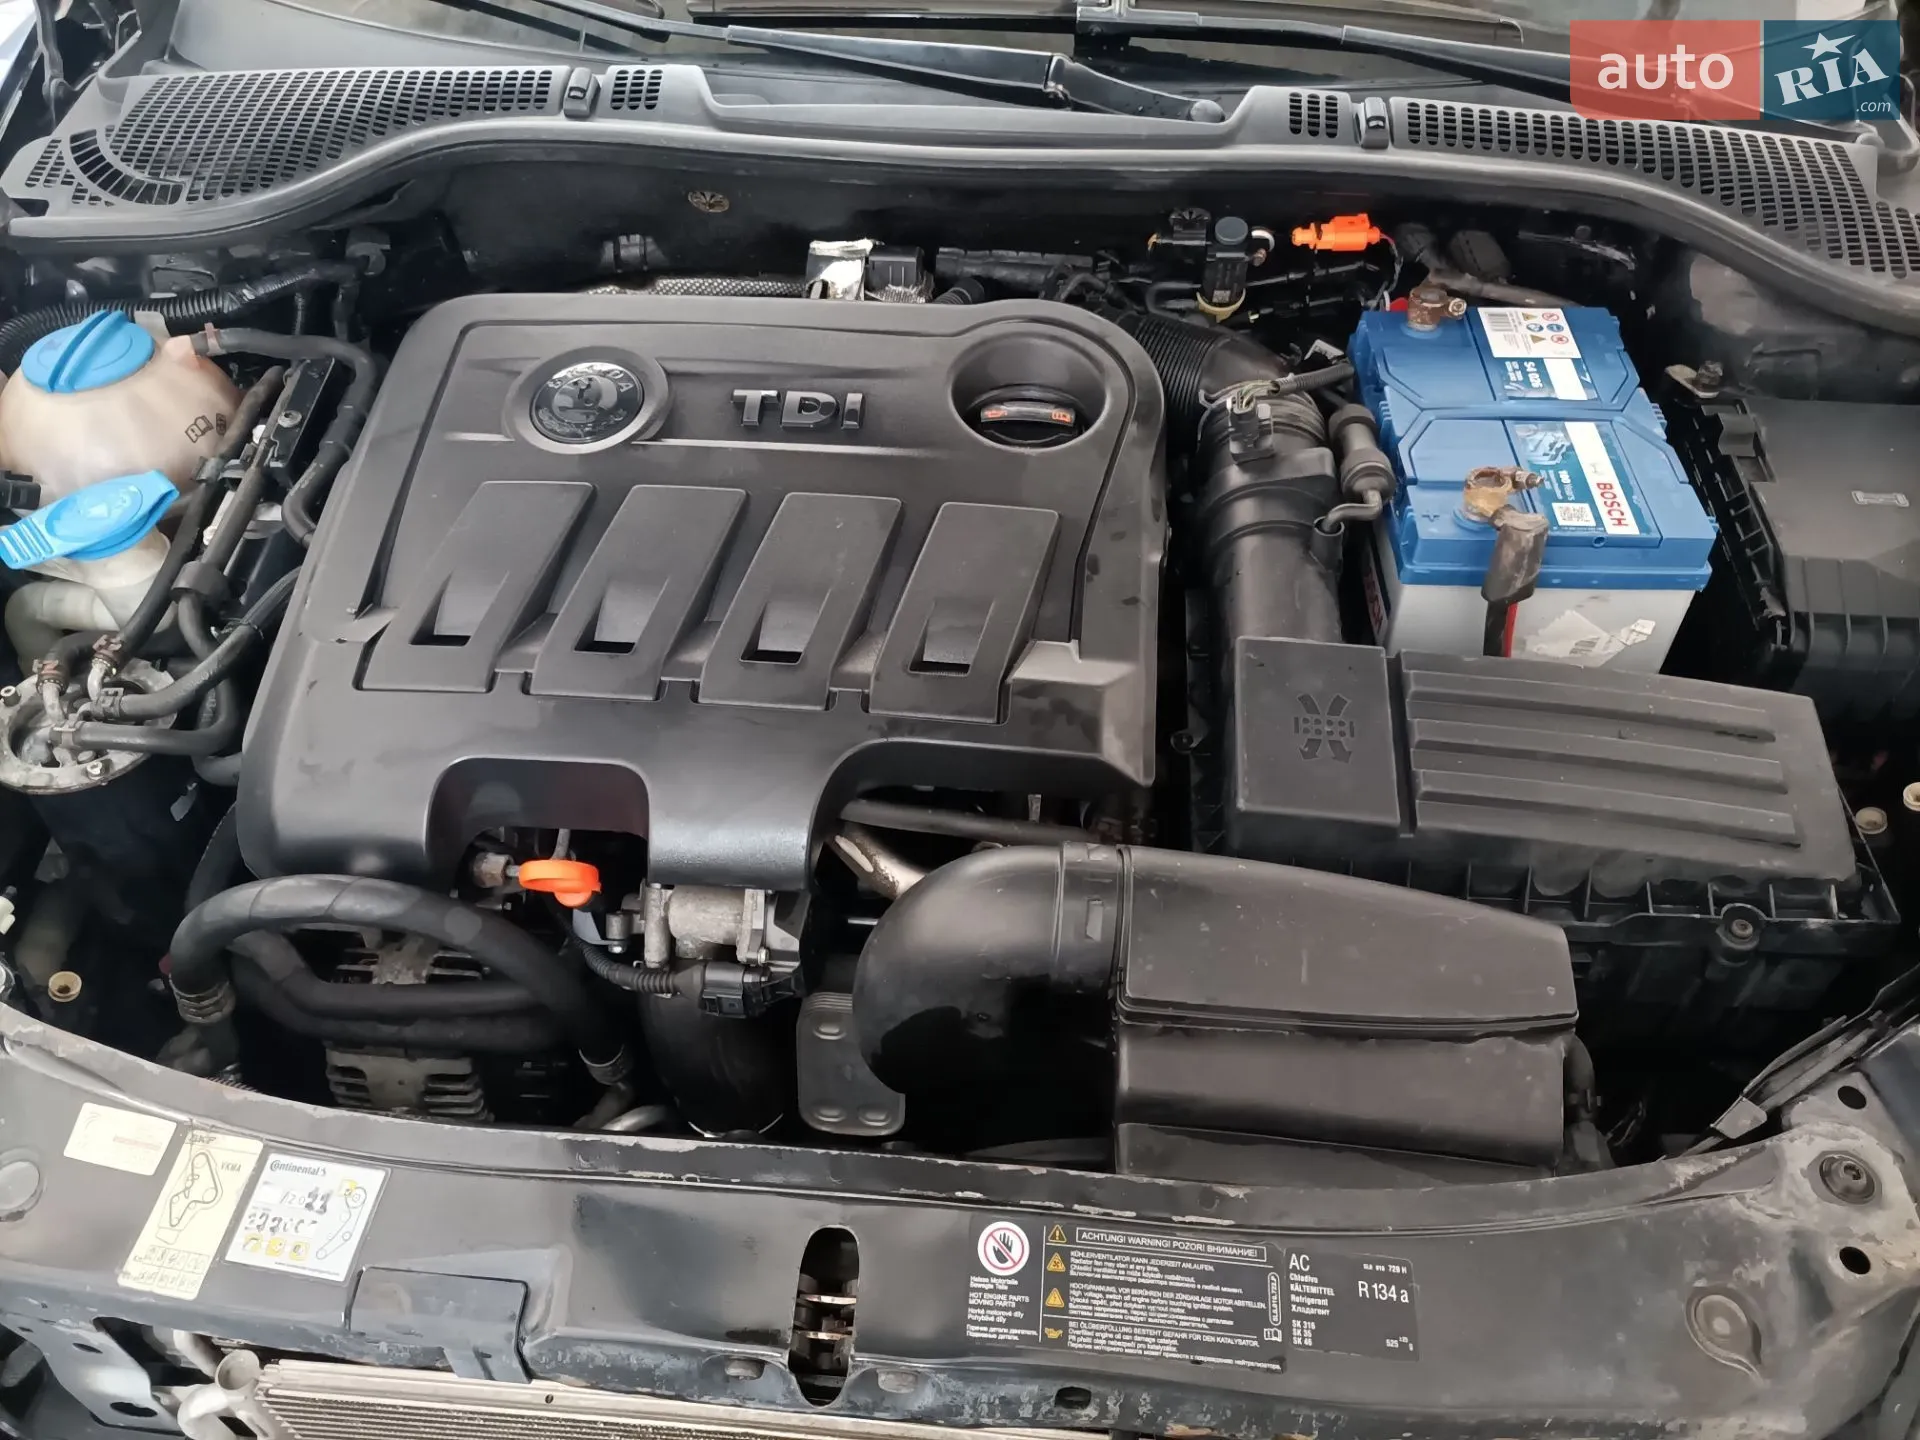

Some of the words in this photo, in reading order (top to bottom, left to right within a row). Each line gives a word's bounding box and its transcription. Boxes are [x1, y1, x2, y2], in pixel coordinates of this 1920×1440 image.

[731, 388, 864, 430] TDI
[1596, 482, 1629, 527] BOSCH
[270, 1160, 319, 1176] Continental
[1081, 1231, 1125, 1243] ACHTUNG!
[1127, 1236, 1170, 1248] WARNING!
[1172, 1240, 1205, 1252] POZOR!
[1206, 1244, 1257, 1257] ВНИМАНИЕ!
[1130, 1255, 1148, 1264] KANN
[1289, 1253, 1310, 1271] AC
[1290, 1283, 1335, 1296] KÄLTEMITTEL
[1358, 1280, 1370, 1298] R
[1371, 1283, 1397, 1301] 134
[1400, 1289, 1409, 1303] a
[1292, 1320, 1301, 1328] SK
[1293, 1337, 1302, 1345] SK
